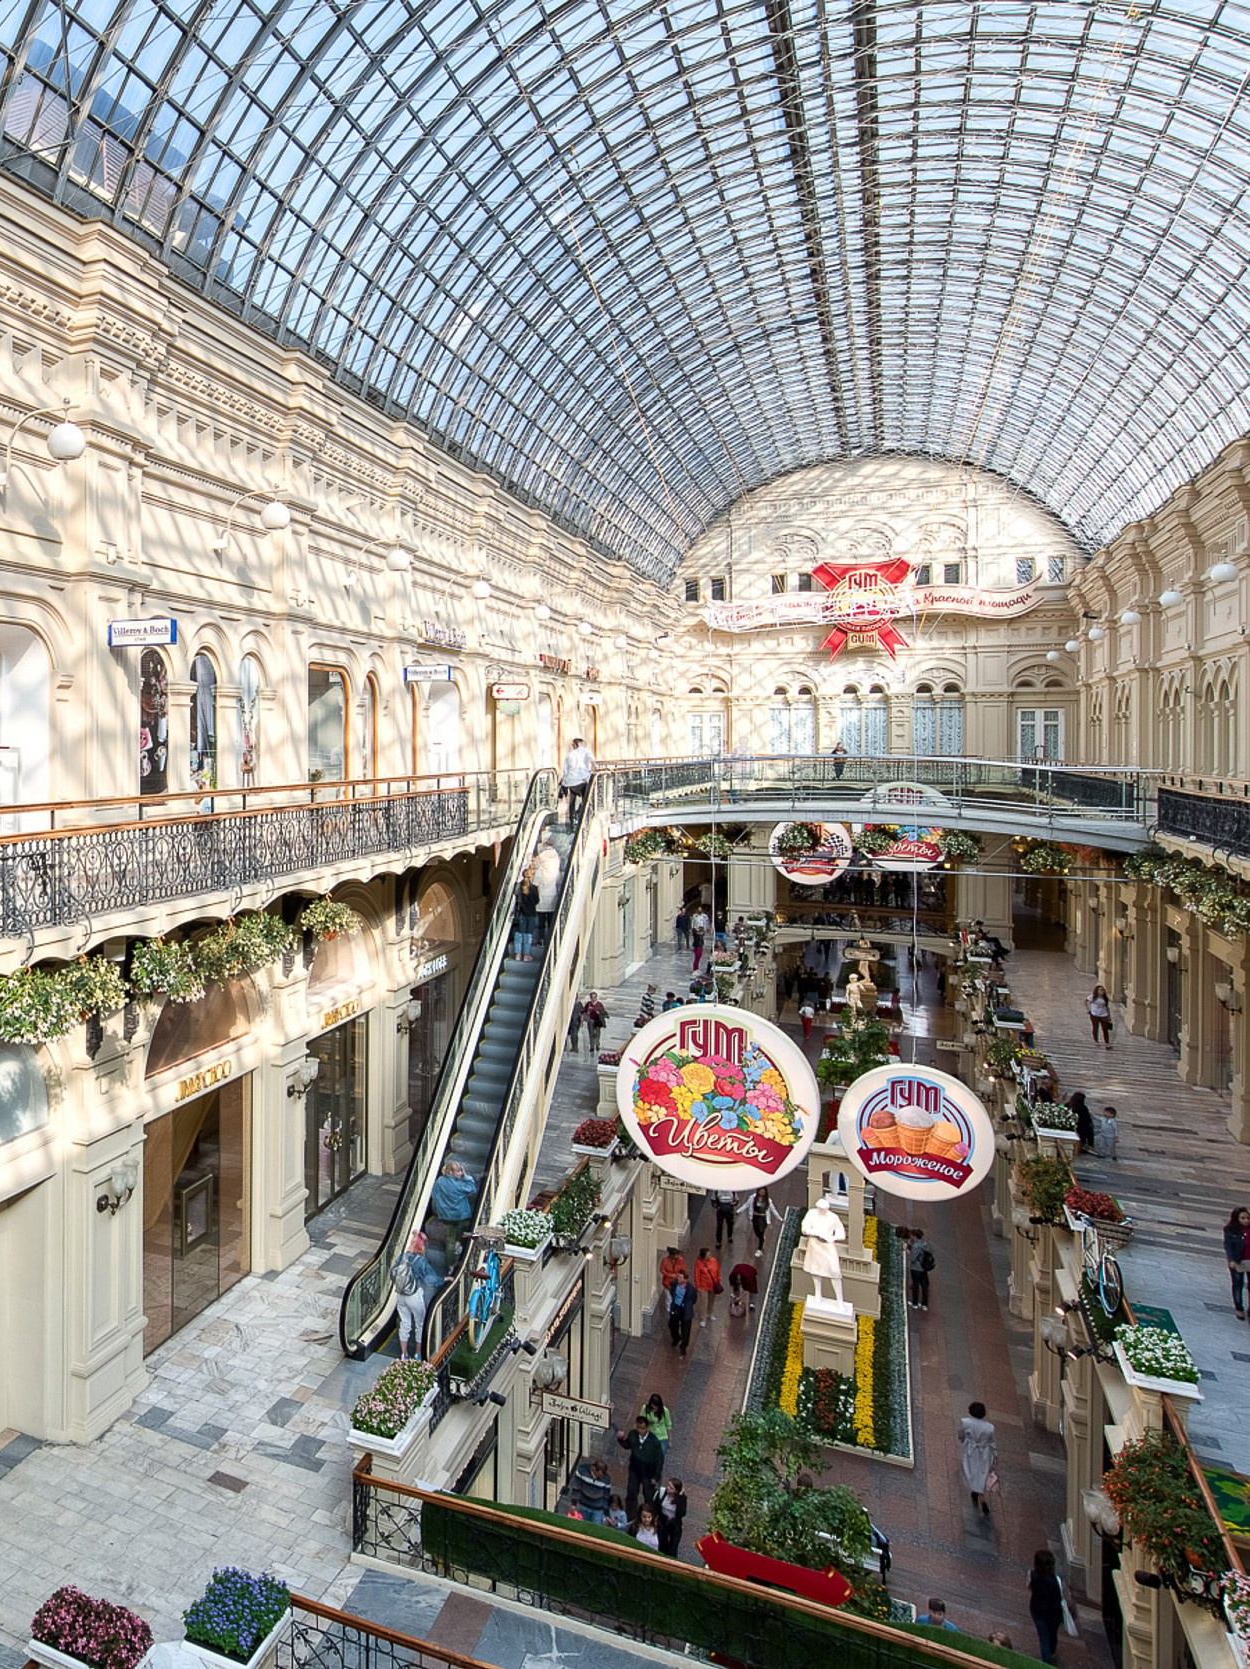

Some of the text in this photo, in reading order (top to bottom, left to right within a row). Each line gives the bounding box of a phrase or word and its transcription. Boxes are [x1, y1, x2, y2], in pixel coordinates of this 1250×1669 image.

[848, 572, 878, 589] ГУМ
[923, 592, 974, 605] Красной
[979, 592, 1032, 609] площади
[113, 626, 142, 636] Villeroy
[149, 625, 169, 634] Boch
[851, 634, 874, 644] GUM
[679, 1019, 744, 1066] ГУМ
[888, 1079, 941, 1114] ГУМ
[649, 1112, 774, 1163] Цветы
[869, 1151, 963, 1180] Мороженое
